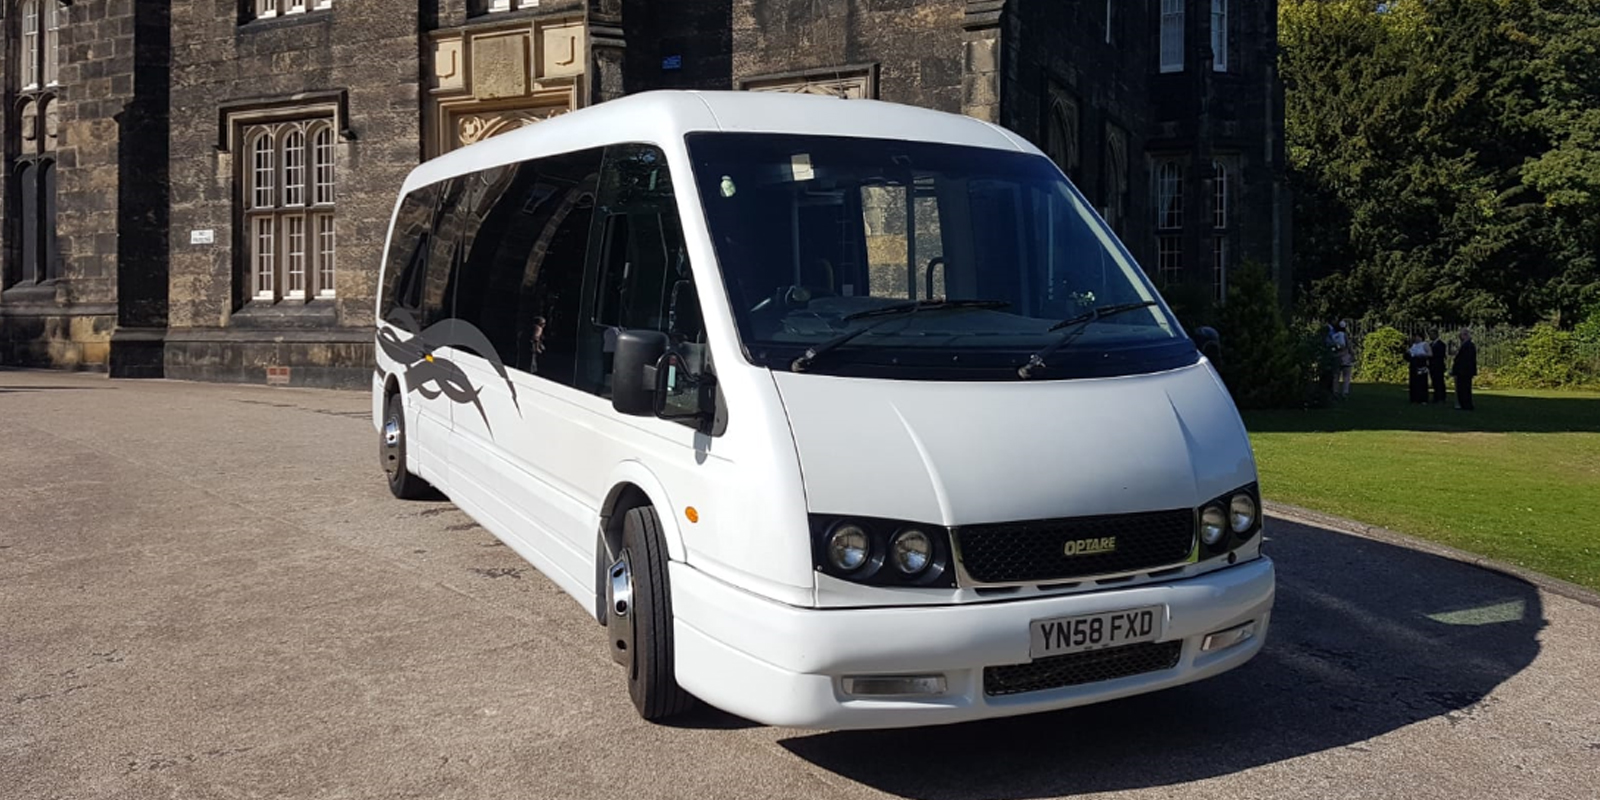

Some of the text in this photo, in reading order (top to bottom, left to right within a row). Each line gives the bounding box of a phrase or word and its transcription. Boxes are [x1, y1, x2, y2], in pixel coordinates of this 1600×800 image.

[1064, 536, 1116, 556] OPTARE
[1041, 610, 1153, 650] YN58 FXD
